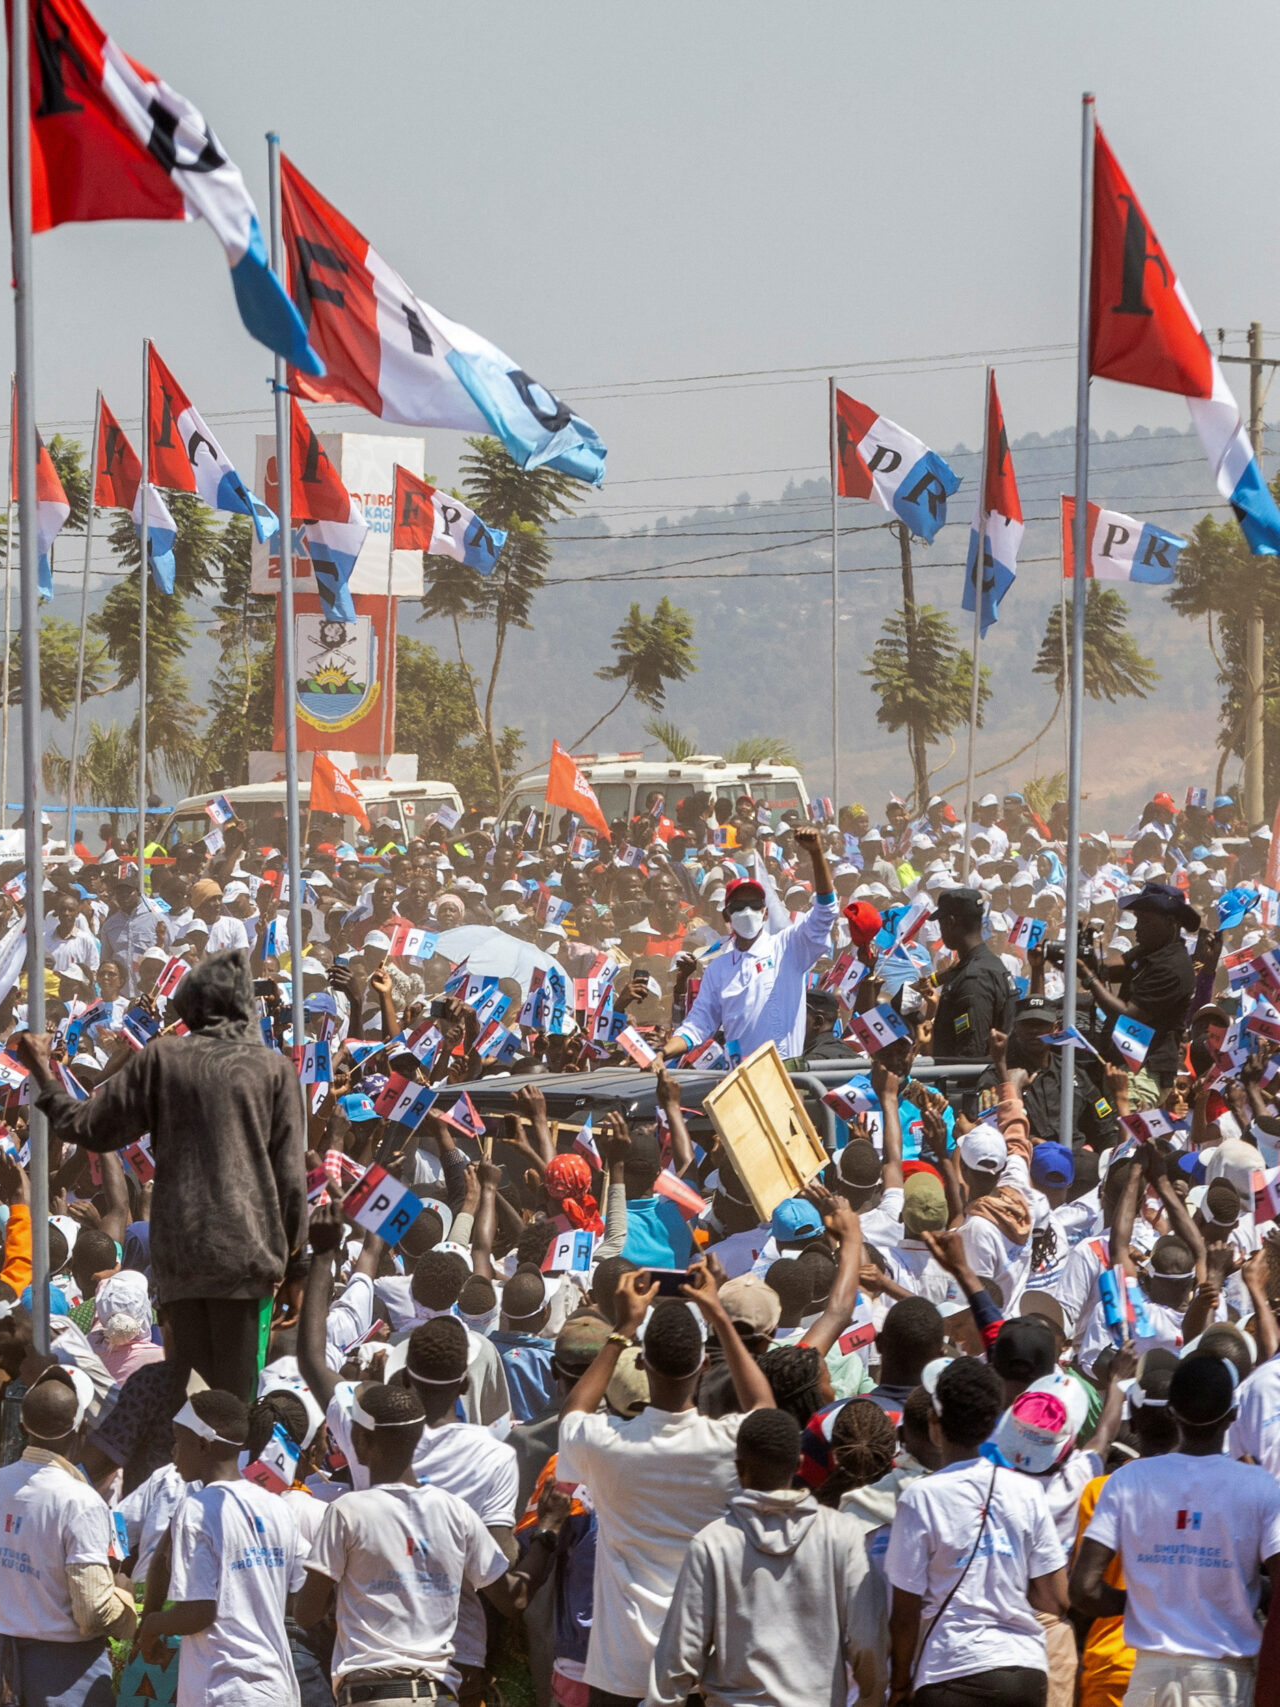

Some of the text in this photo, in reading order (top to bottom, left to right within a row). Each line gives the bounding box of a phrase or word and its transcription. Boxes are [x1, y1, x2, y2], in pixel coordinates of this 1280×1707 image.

[1012, 921, 1042, 943] FPR
[395, 937, 434, 952] FPR
[1030, 998, 1044, 1006] CTU
[383, 1088, 425, 1117] FPR
